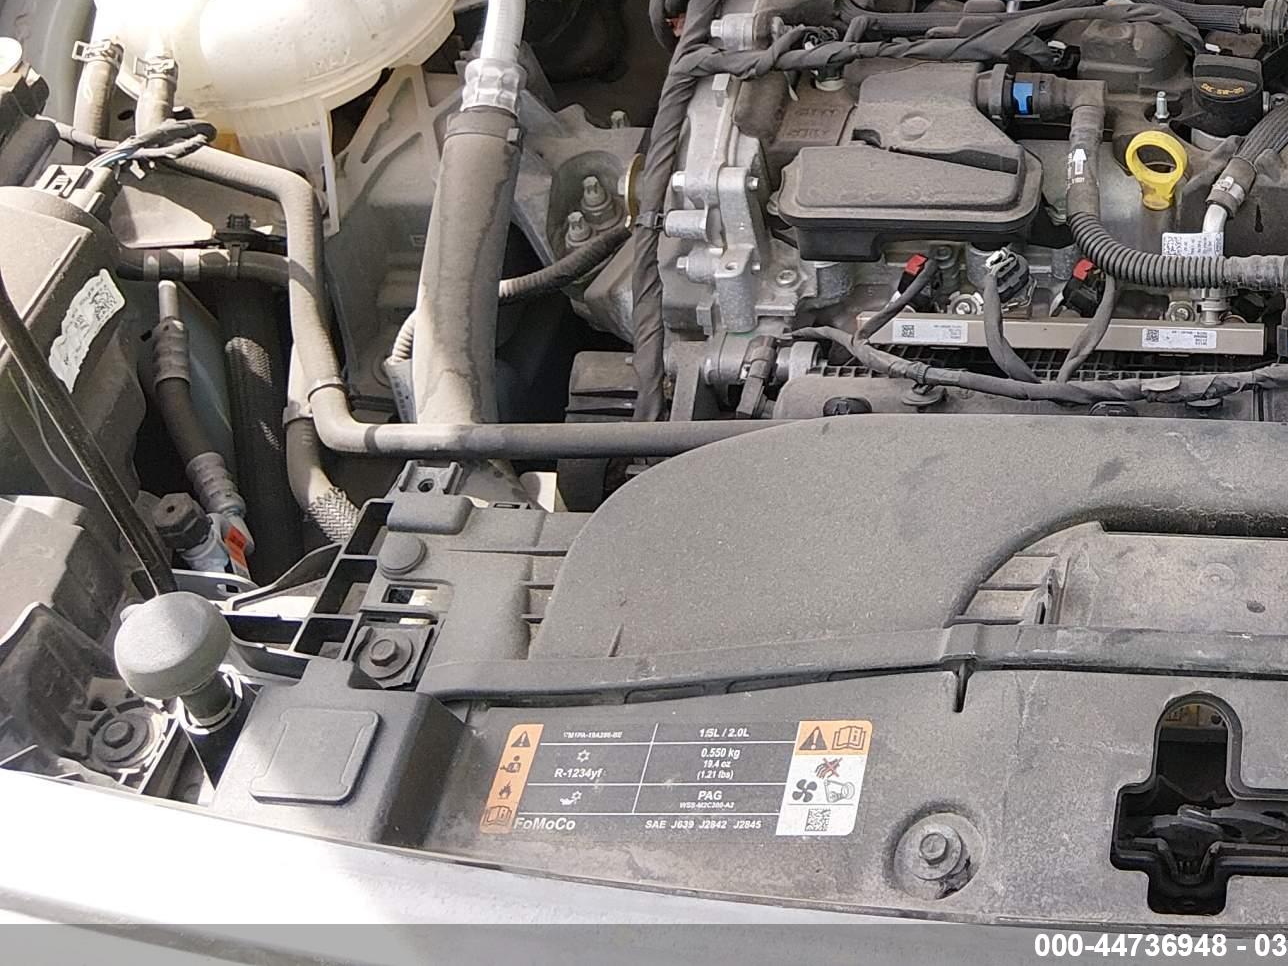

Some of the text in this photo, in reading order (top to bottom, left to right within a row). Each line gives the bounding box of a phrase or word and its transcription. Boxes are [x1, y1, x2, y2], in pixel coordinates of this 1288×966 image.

[727, 728, 750, 738] 2.0L
[701, 747, 741, 760] 0.550 kg
[553, 768, 603, 780] R-1234yf
[697, 790, 722, 801] PAG
[513, 817, 576, 831] FoMoCo
[645, 820, 761, 829] SAE J639 J2842 J2845
